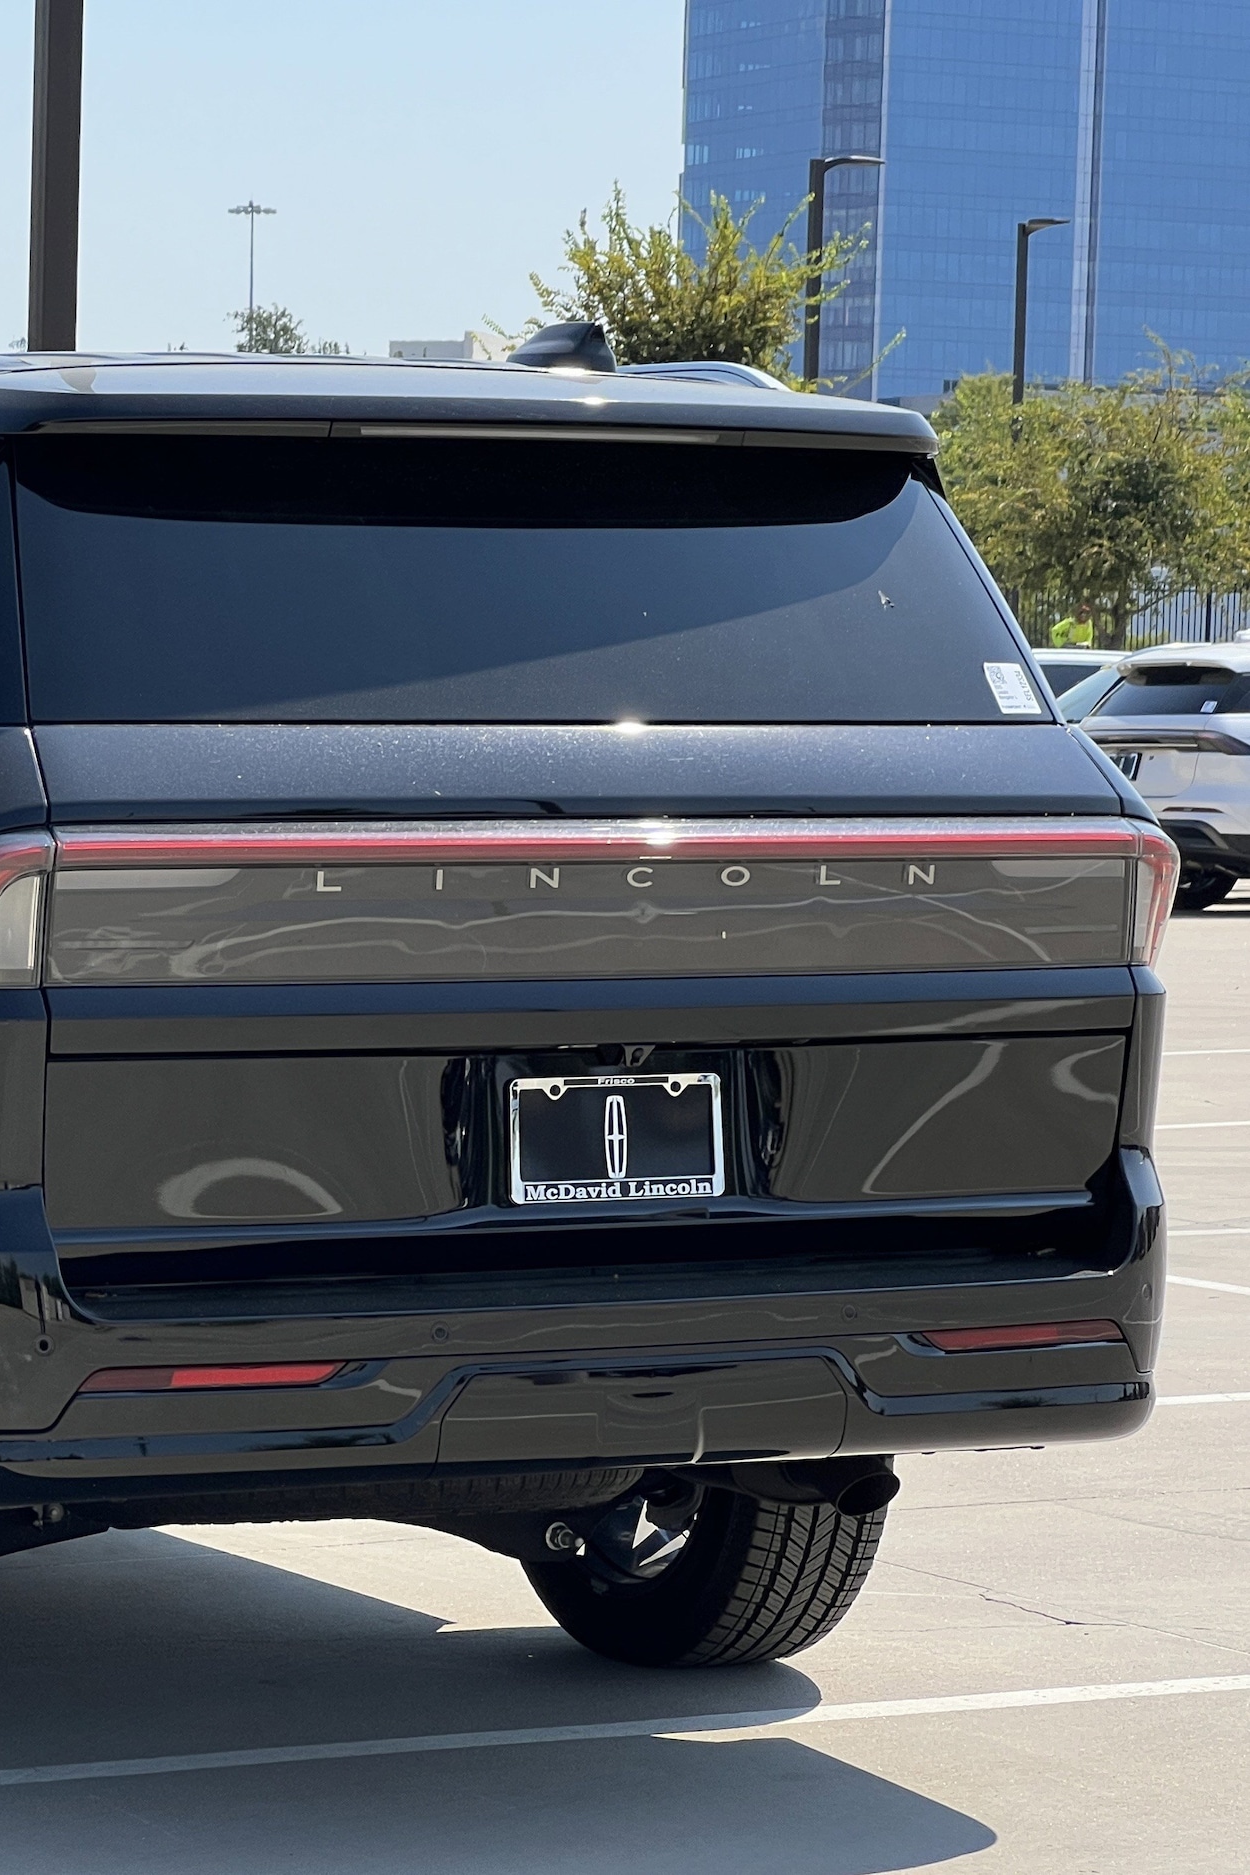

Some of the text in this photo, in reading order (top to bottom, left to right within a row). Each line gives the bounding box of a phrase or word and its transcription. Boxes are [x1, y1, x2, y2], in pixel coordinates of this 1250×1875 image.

[315, 864, 936, 892] LINCOLN
[598, 1077, 635, 1086] Frisco
[525, 1179, 712, 1201] McDavid Lincoln
